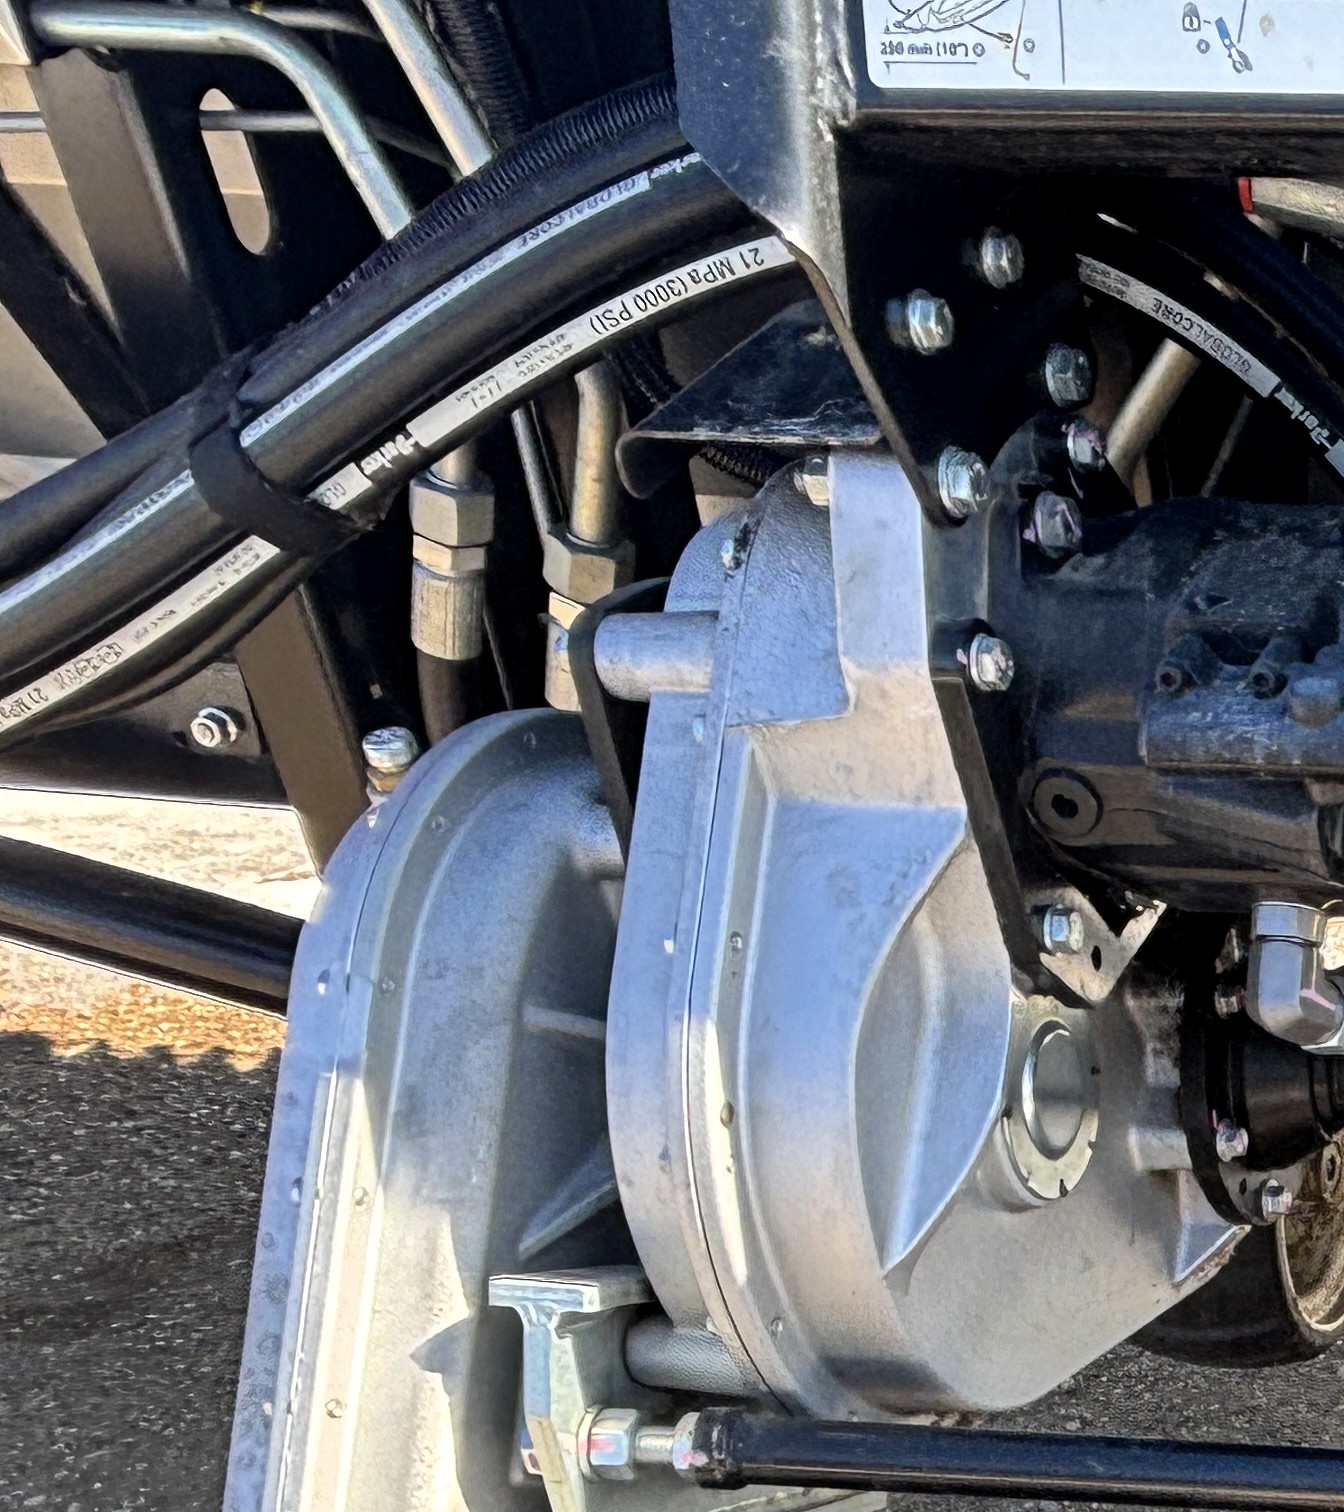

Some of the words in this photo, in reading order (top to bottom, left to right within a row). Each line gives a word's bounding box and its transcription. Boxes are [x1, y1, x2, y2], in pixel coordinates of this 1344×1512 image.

[687, 255, 736, 286] MPa
[738, 246, 765, 270] 21
[628, 274, 689, 314] (3000
[589, 303, 634, 336] PSI)
[1152, 297, 1252, 376] GLOBALCORE
